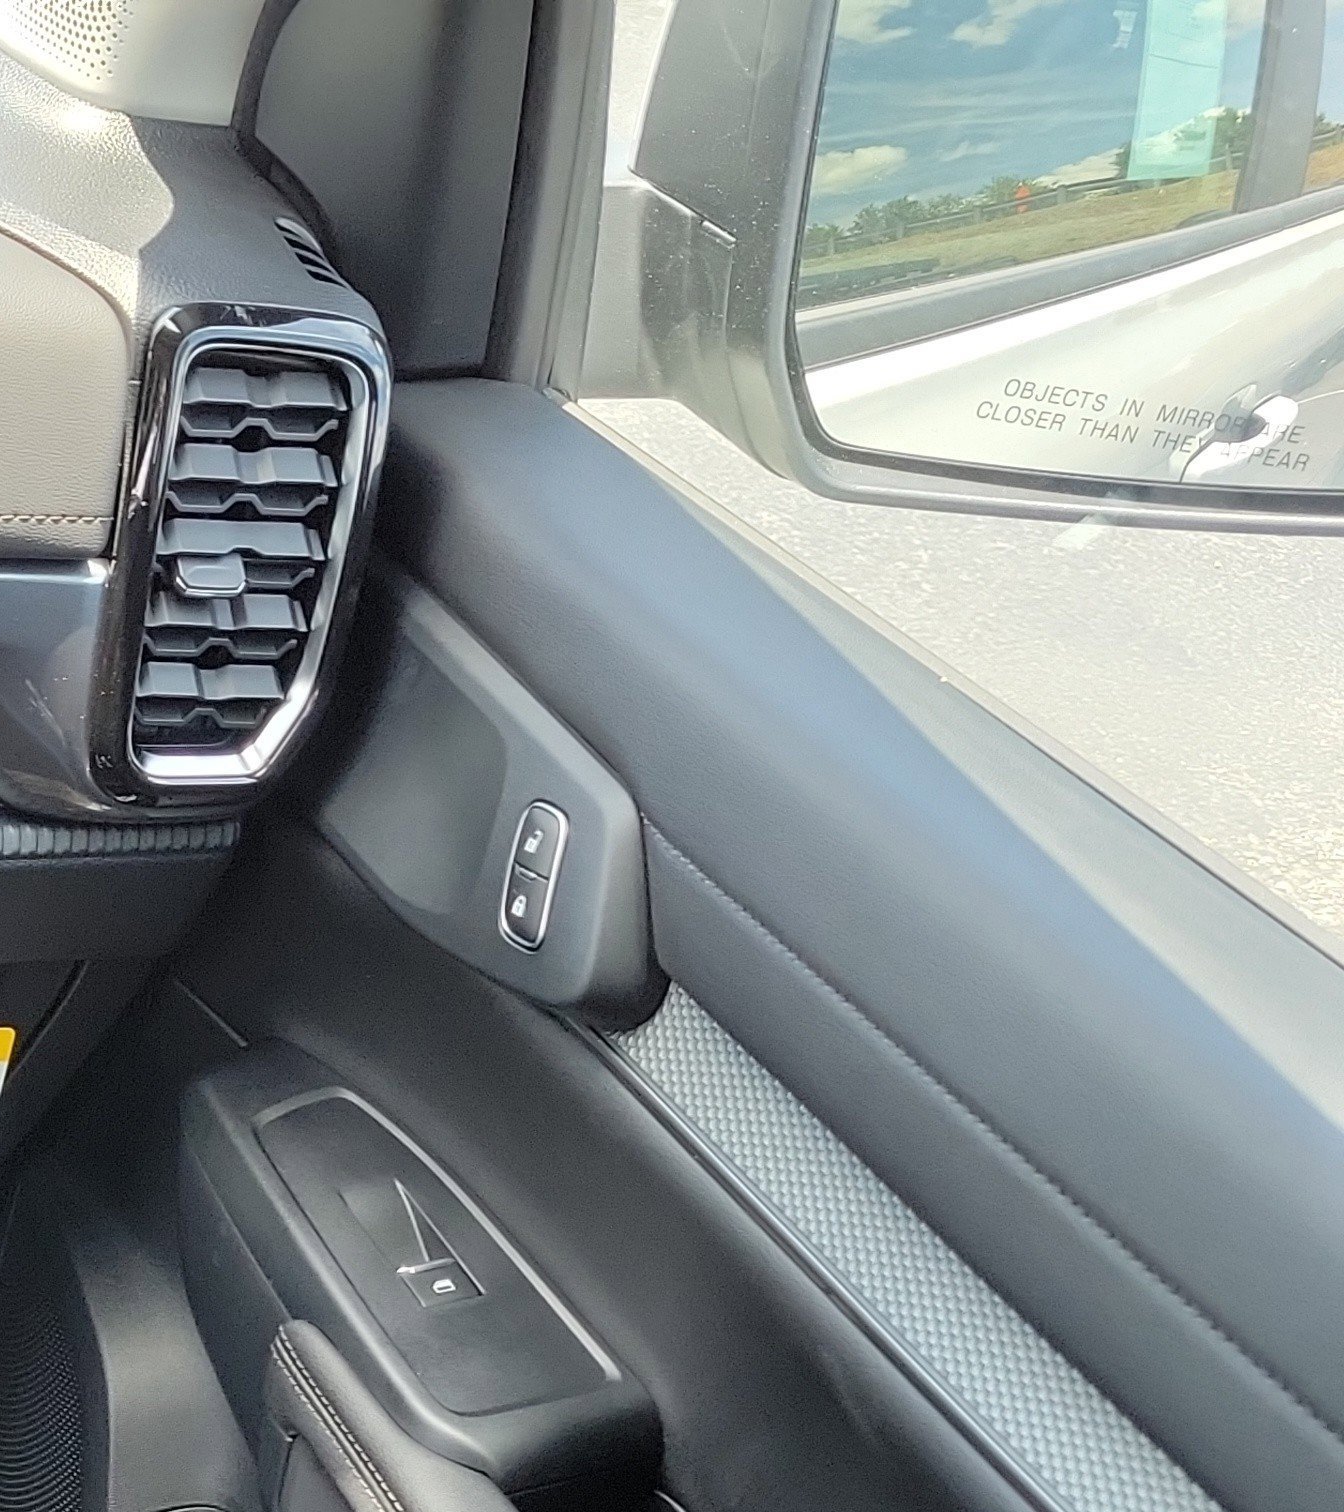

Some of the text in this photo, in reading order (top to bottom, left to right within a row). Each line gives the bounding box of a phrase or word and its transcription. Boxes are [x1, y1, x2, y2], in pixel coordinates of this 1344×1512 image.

[975, 401, 1067, 432] CLOSER
[1079, 418, 1139, 444] THAN
[1152, 429, 1208, 454] THEY
[1003, 378, 1108, 412] OBJECTS
[1119, 398, 1145, 418] IN
[1157, 403, 1247, 436] MIRROR
